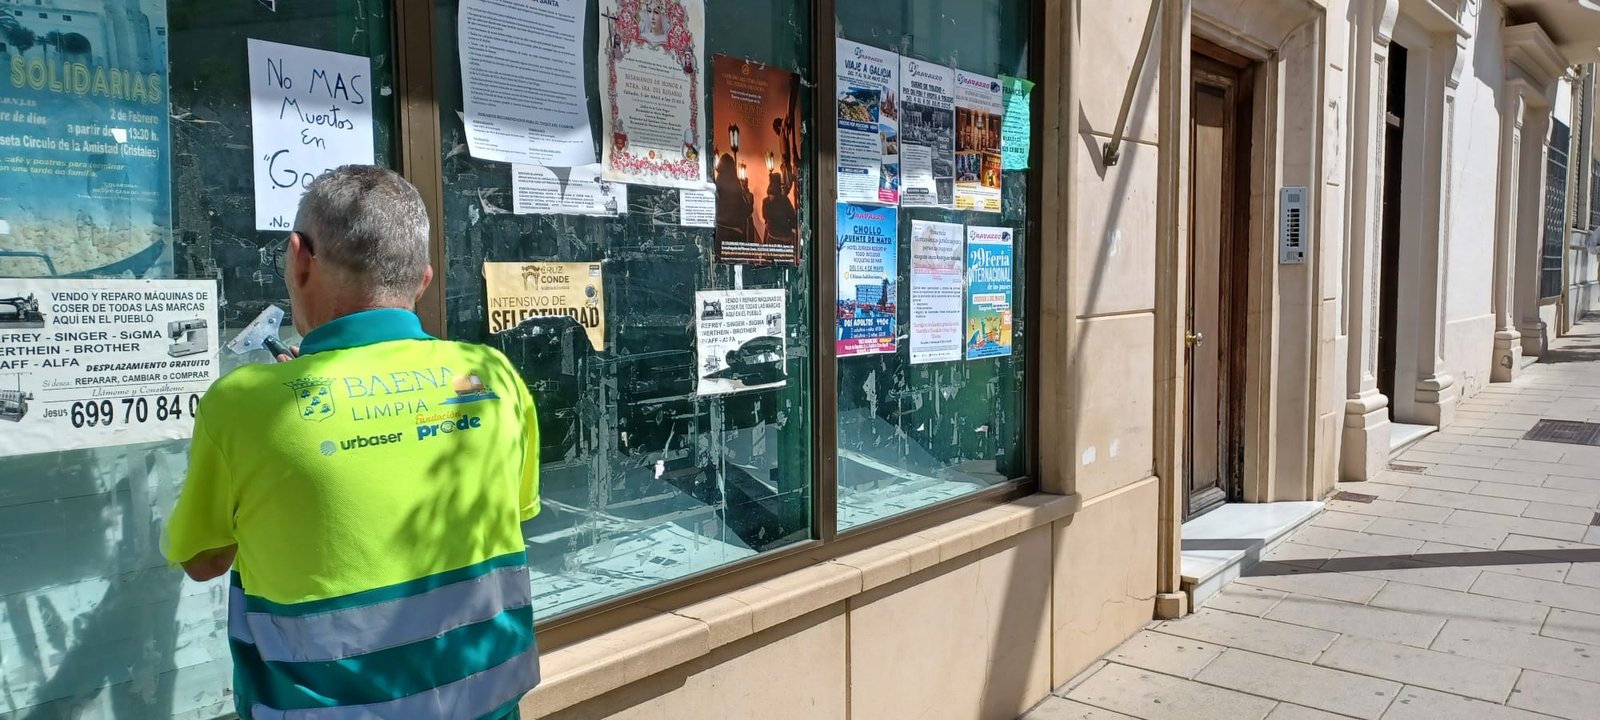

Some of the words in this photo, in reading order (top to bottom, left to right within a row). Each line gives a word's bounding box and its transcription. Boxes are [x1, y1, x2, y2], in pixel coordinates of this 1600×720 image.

[845, 59, 862, 72] VIAJE
[863, 64, 868, 73] A
[869, 65, 892, 79] GALICIA
[10, 54, 162, 104] SOLIDARIAS
[267, 57, 293, 90] No
[309, 69, 364, 105] MAS
[12, 111, 25, 122] de
[26, 112, 47, 125] dios
[110, 108, 117, 120] 2
[117, 109, 127, 122] de
[128, 111, 159, 124] Febrero
[280, 96, 353, 130] Muertos
[67, 125, 73, 133] a
[75, 125, 100, 136] partir
[103, 126, 112, 136] de
[128, 128, 149, 141] 13:30
[151, 130, 159, 141] h.
[301, 128, 326, 150] En
[23, 135, 56, 149] Circulo
[58, 138, 69, 151] de
[72, 140, 81, 151] la
[83, 141, 118, 155] Amistad
[121, 144, 159, 160] (Cristales)
[68, 160, 88, 168] para
[853, 225, 882, 234] CHOLLO
[985, 250, 1010, 267] Feria
[540, 266, 563, 274] CRUZ
[969, 267, 1011, 285] INTERNACIONAL
[541, 275, 570, 284] CONDE
[51, 292, 89, 301] VENDO
[91, 292, 99, 301] Y
[101, 291, 142, 301] REPARO
[144, 290, 193, 301] MÁQUINAS
[195, 291, 208, 300] DE
[490, 296, 550, 308] INTENSIVO
[552, 295, 566, 306] DE
[52, 304, 90, 313] COSER
[92, 303, 107, 312] DE
[109, 303, 142, 312] TODAS
[145, 303, 164, 312] LAS
[166, 302, 205, 311] MARCAS
[52, 313, 80, 324] AQUÍ
[82, 315, 96, 324] EN
[99, 315, 112, 324] EL
[114, 314, 154, 323] PUEBLO
[0, 333, 41, 343] FREY
[55, 332, 108, 341] SINGER
[0, 345, 60, 356] ERTHEIN
[74, 343, 140, 354] BROTHER
[0, 359, 29, 370] AFF
[42, 358, 80, 368] ALFA
[86, 361, 167, 372] DESPLAZAMIENTO
[169, 359, 210, 368] GRATUITO
[75, 375, 120, 386] REPARAR,
[122, 373, 161, 382] CAMBIAR
[169, 370, 209, 380] COMPRAR
[43, 407, 68, 419] Jesus
[71, 399, 114, 429] 699
[121, 397, 148, 425] 70
[156, 394, 182, 421] 84
[189, 393, 200, 418] 0
[352, 399, 429, 422] LIMPIA
[340, 432, 403, 451] urbaser
